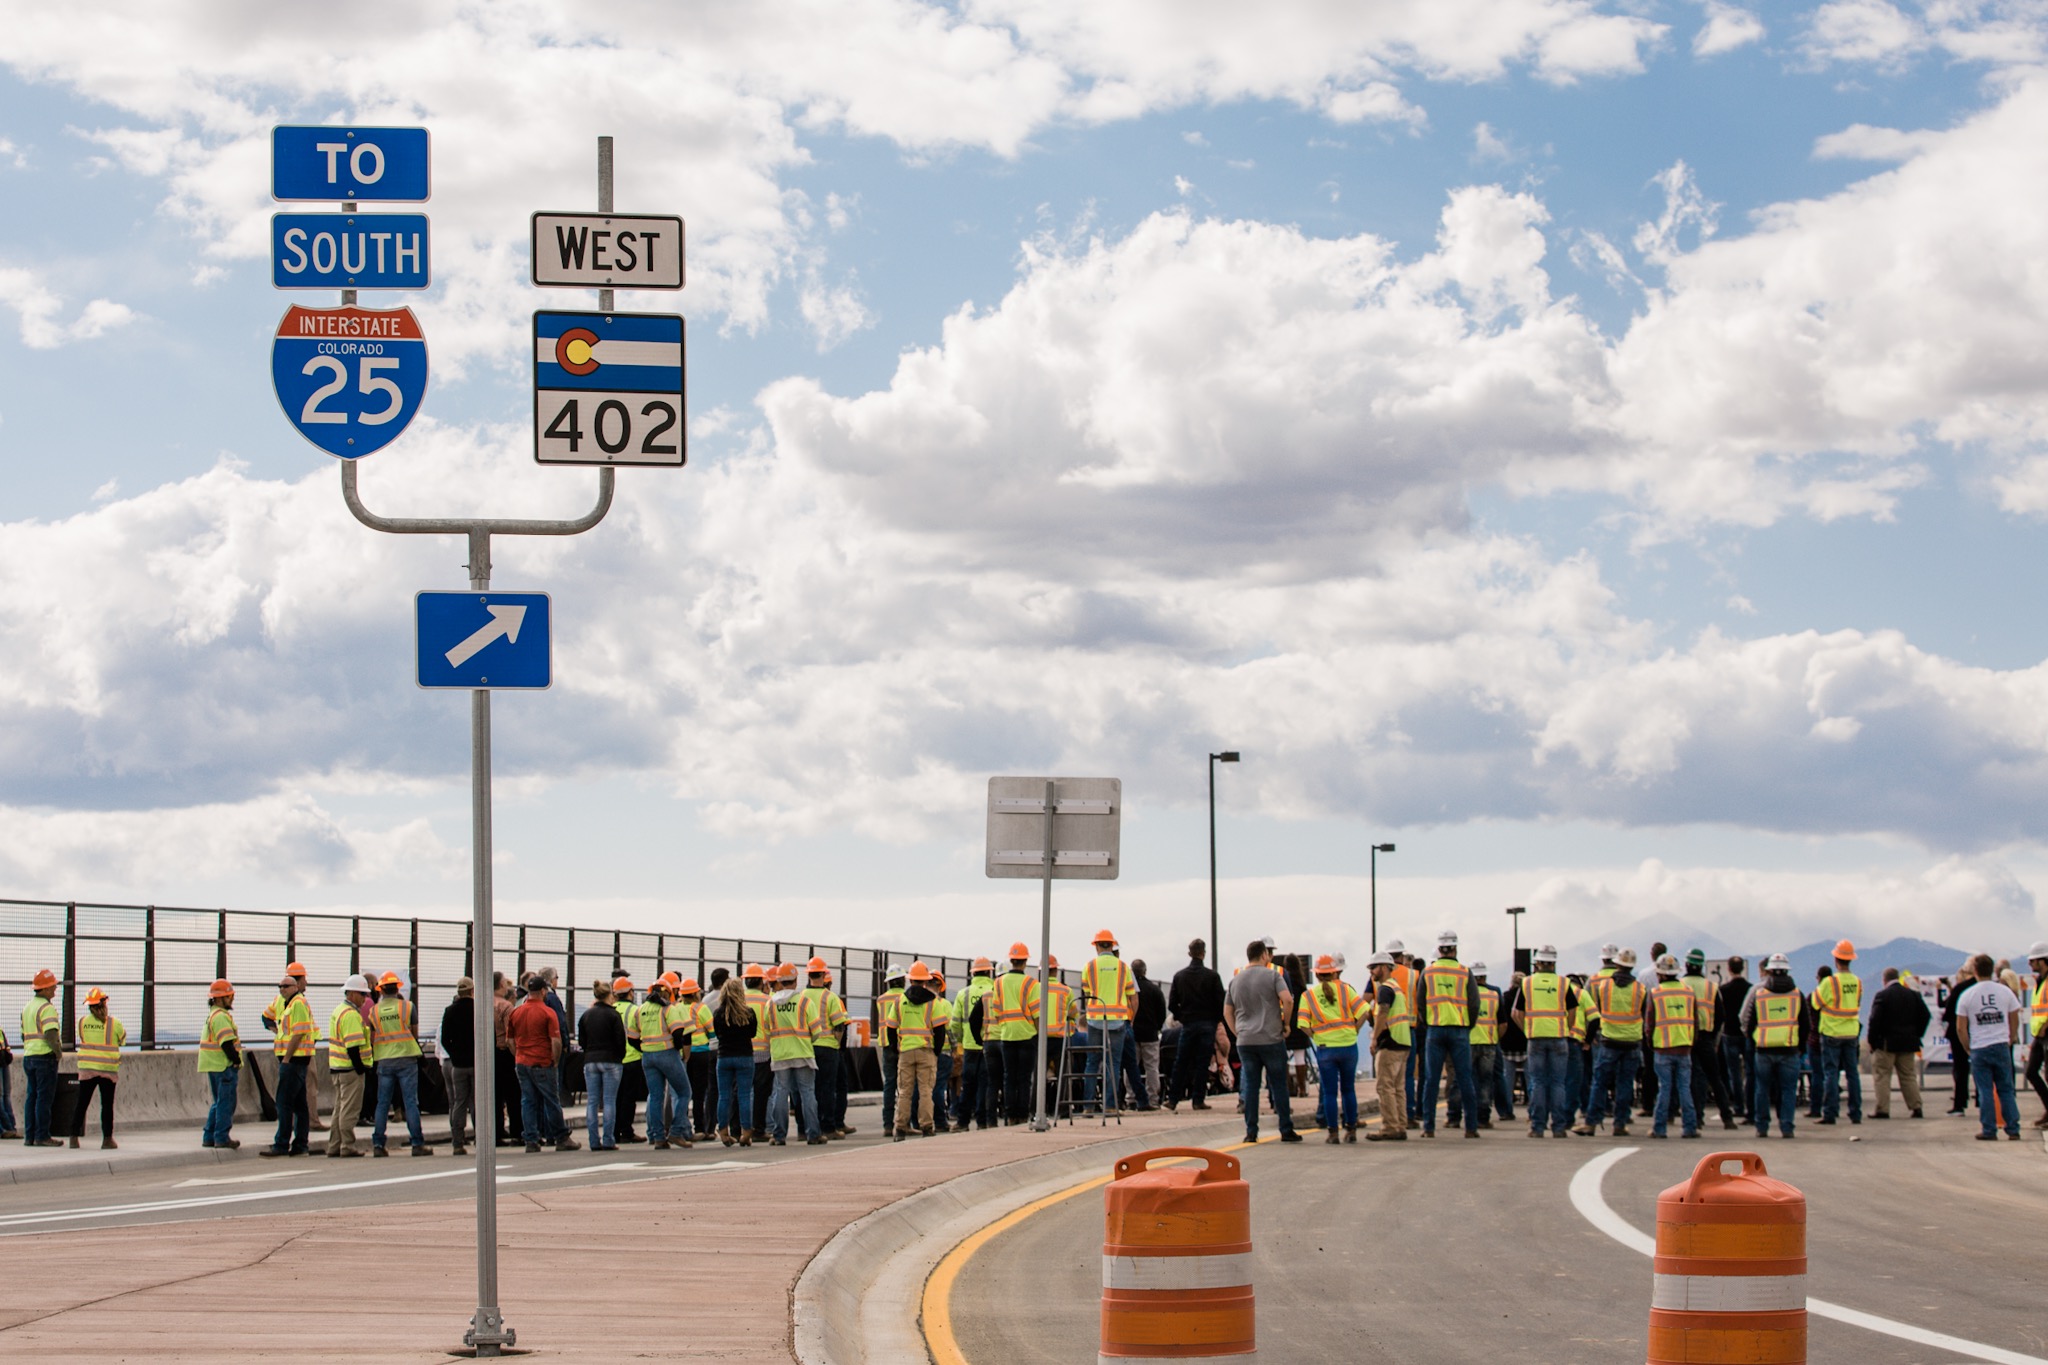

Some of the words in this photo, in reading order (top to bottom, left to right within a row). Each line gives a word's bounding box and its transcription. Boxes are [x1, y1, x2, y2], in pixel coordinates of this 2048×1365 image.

[316, 142, 385, 185] TO
[282, 227, 420, 274] SOUTH
[555, 225, 661, 273] WEST
[299, 315, 401, 336] INTERSTATE
[317, 342, 384, 355] COLORADO
[300, 355, 403, 426] 25
[543, 399, 677, 455] 402
[380, 1013, 400, 1023] ATKINS
